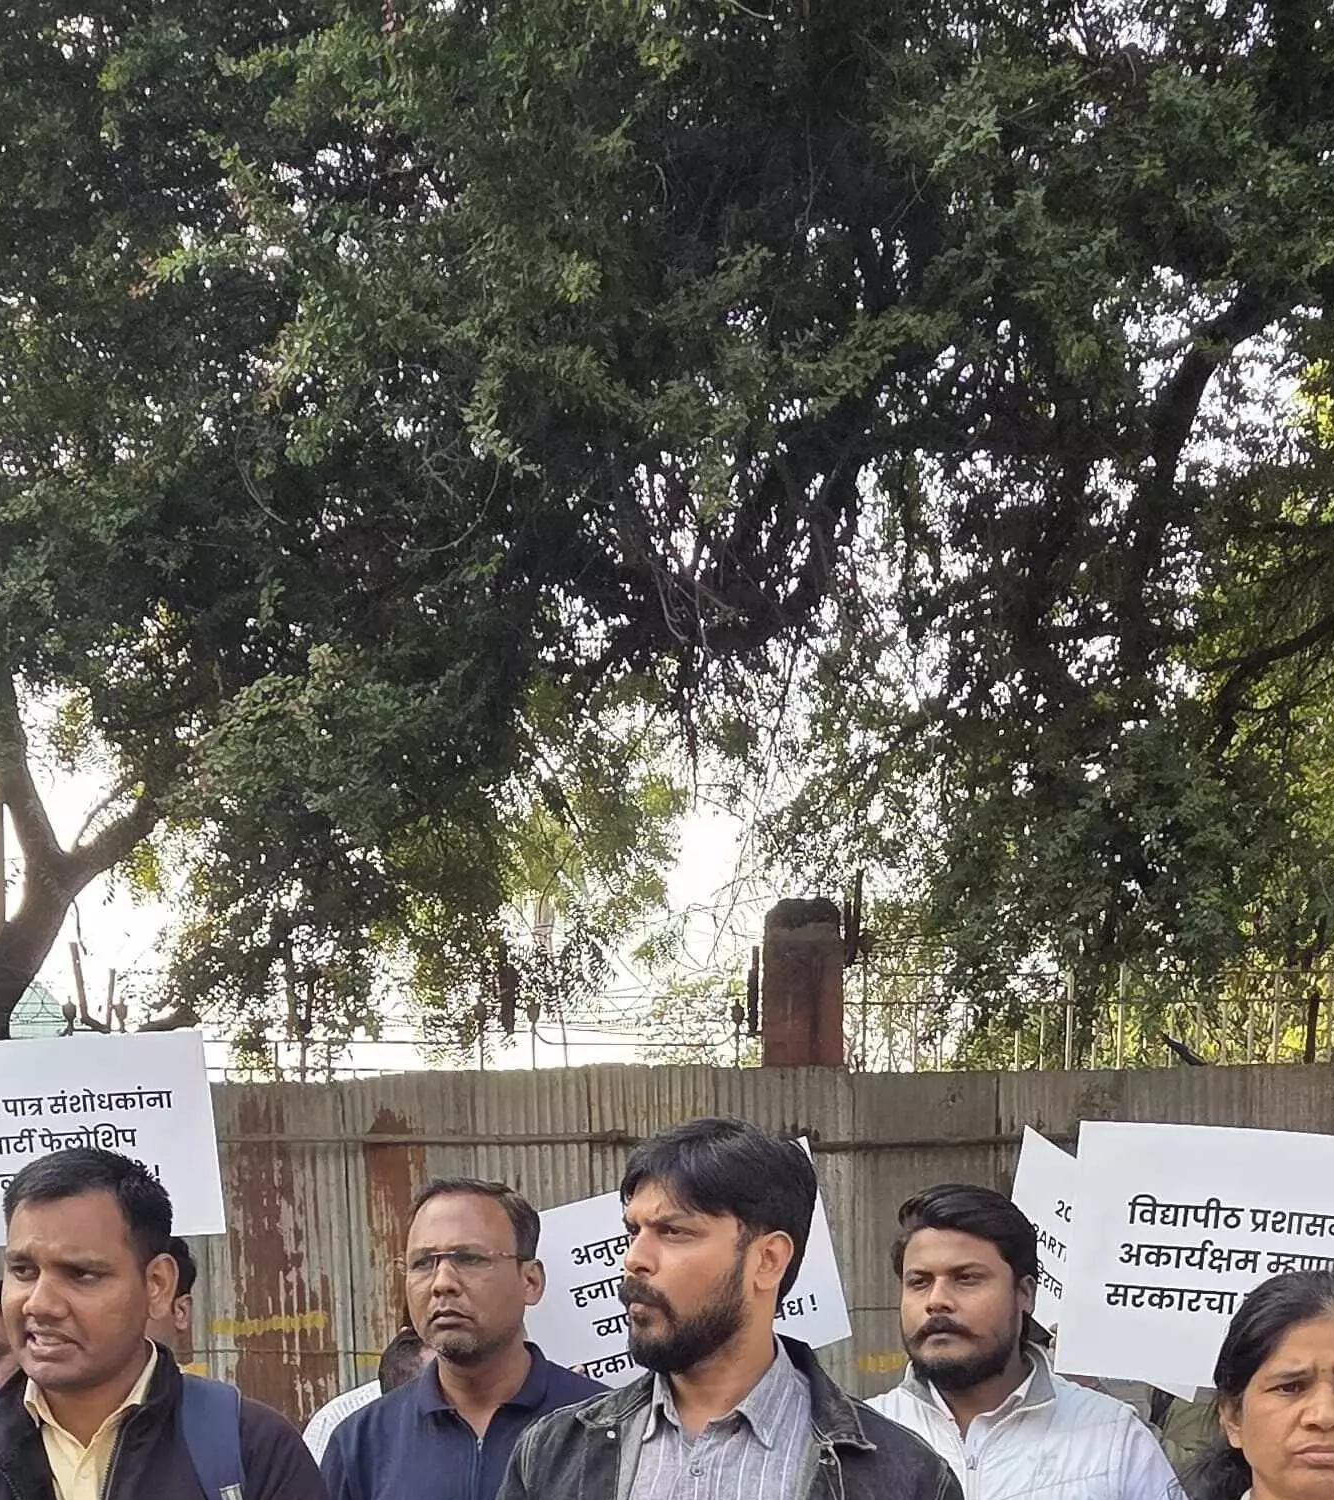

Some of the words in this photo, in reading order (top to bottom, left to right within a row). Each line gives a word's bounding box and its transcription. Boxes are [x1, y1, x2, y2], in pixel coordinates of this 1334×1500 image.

[1, 1097, 43, 1116] पात्र
[48, 1086, 172, 1114] संशोधकांना
[40, 1124, 137, 1152] फेलोशिप
[1128, 1194, 1245, 1231] विद्यापीठ
[1119, 1240, 1259, 1275] अकार्यक्षम
[1105, 1282, 1237, 1316] सरकारचा
